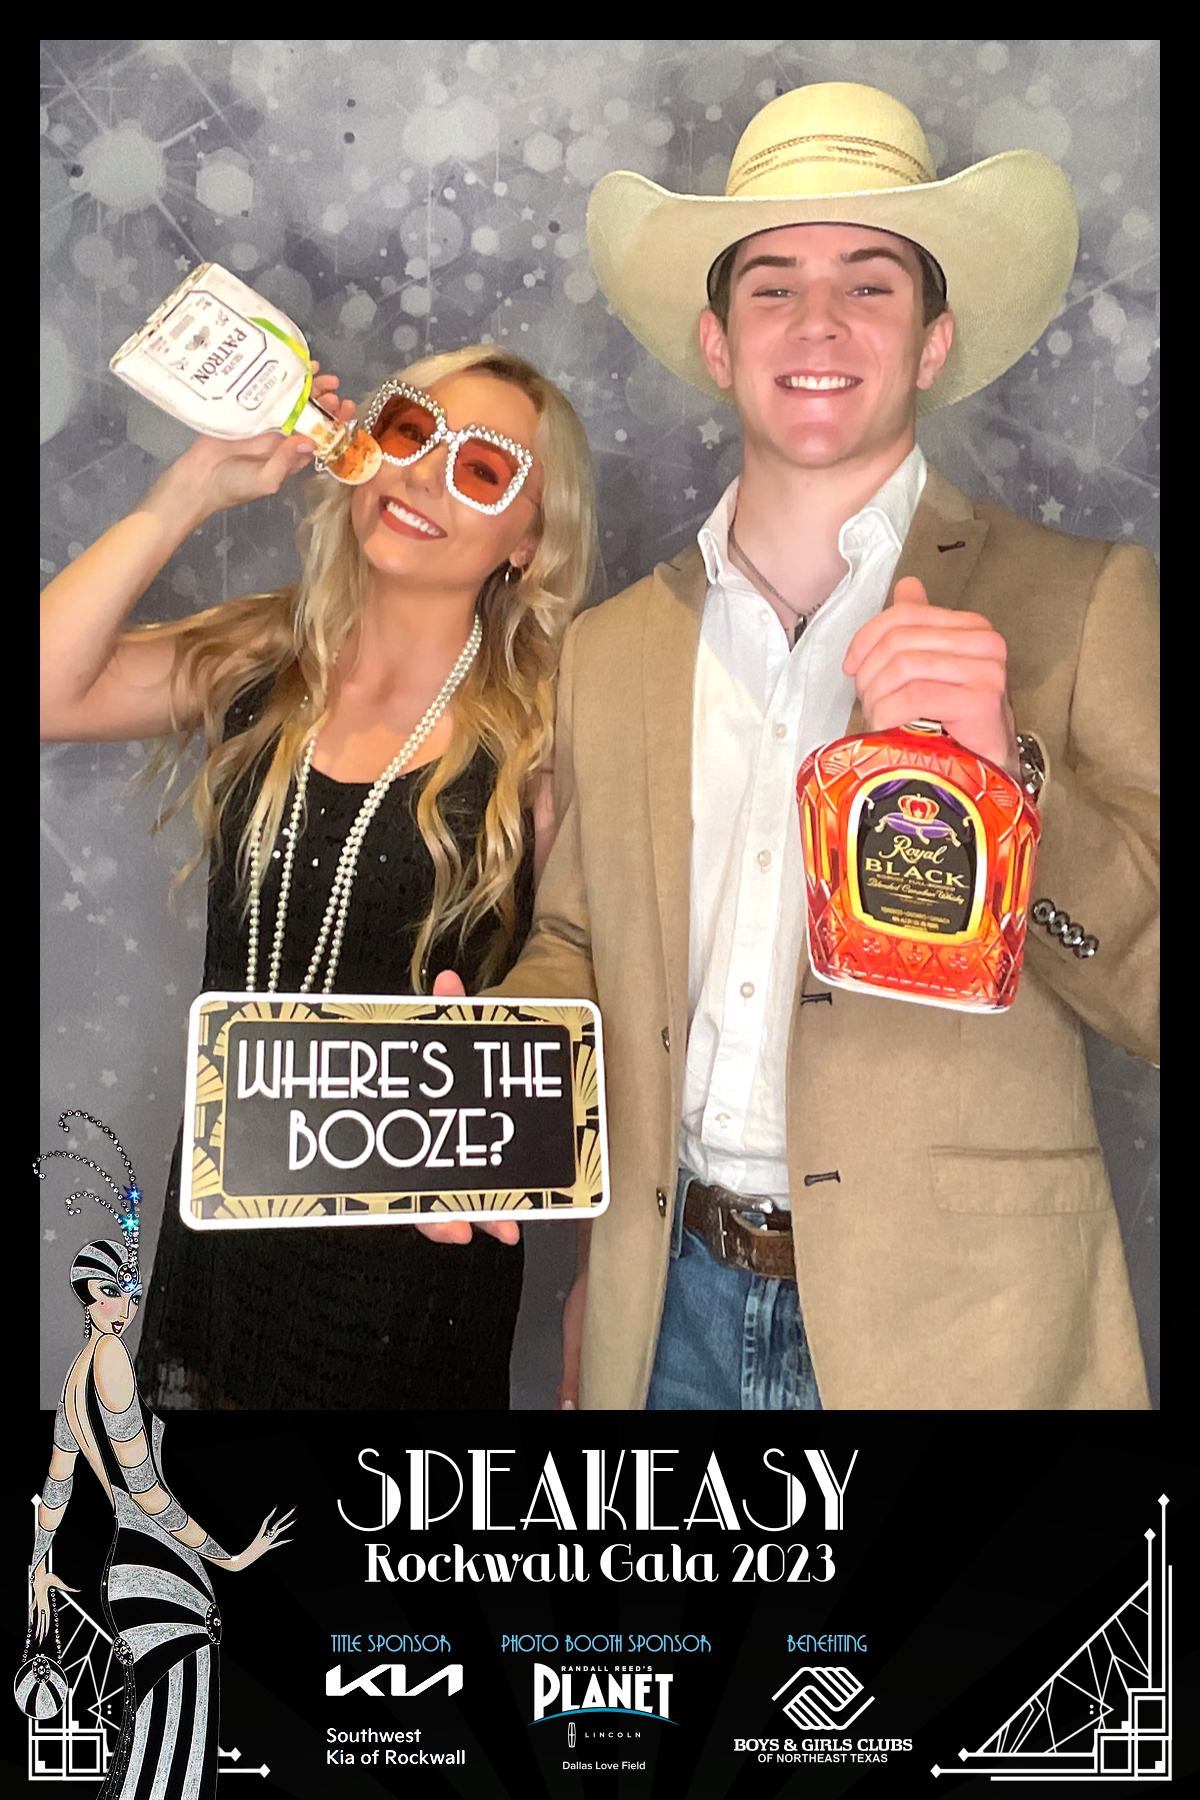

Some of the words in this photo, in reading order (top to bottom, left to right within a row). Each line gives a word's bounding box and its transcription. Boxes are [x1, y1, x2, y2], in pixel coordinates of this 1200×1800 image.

[191, 327, 248, 385] PATRÓN
[865, 857, 970, 889] BLACK
[878, 835, 948, 864] Royal
[237, 1039, 454, 1100] WHERE'S
[473, 1041, 563, 1098] THE
[288, 1108, 515, 1171] BOOZE?
